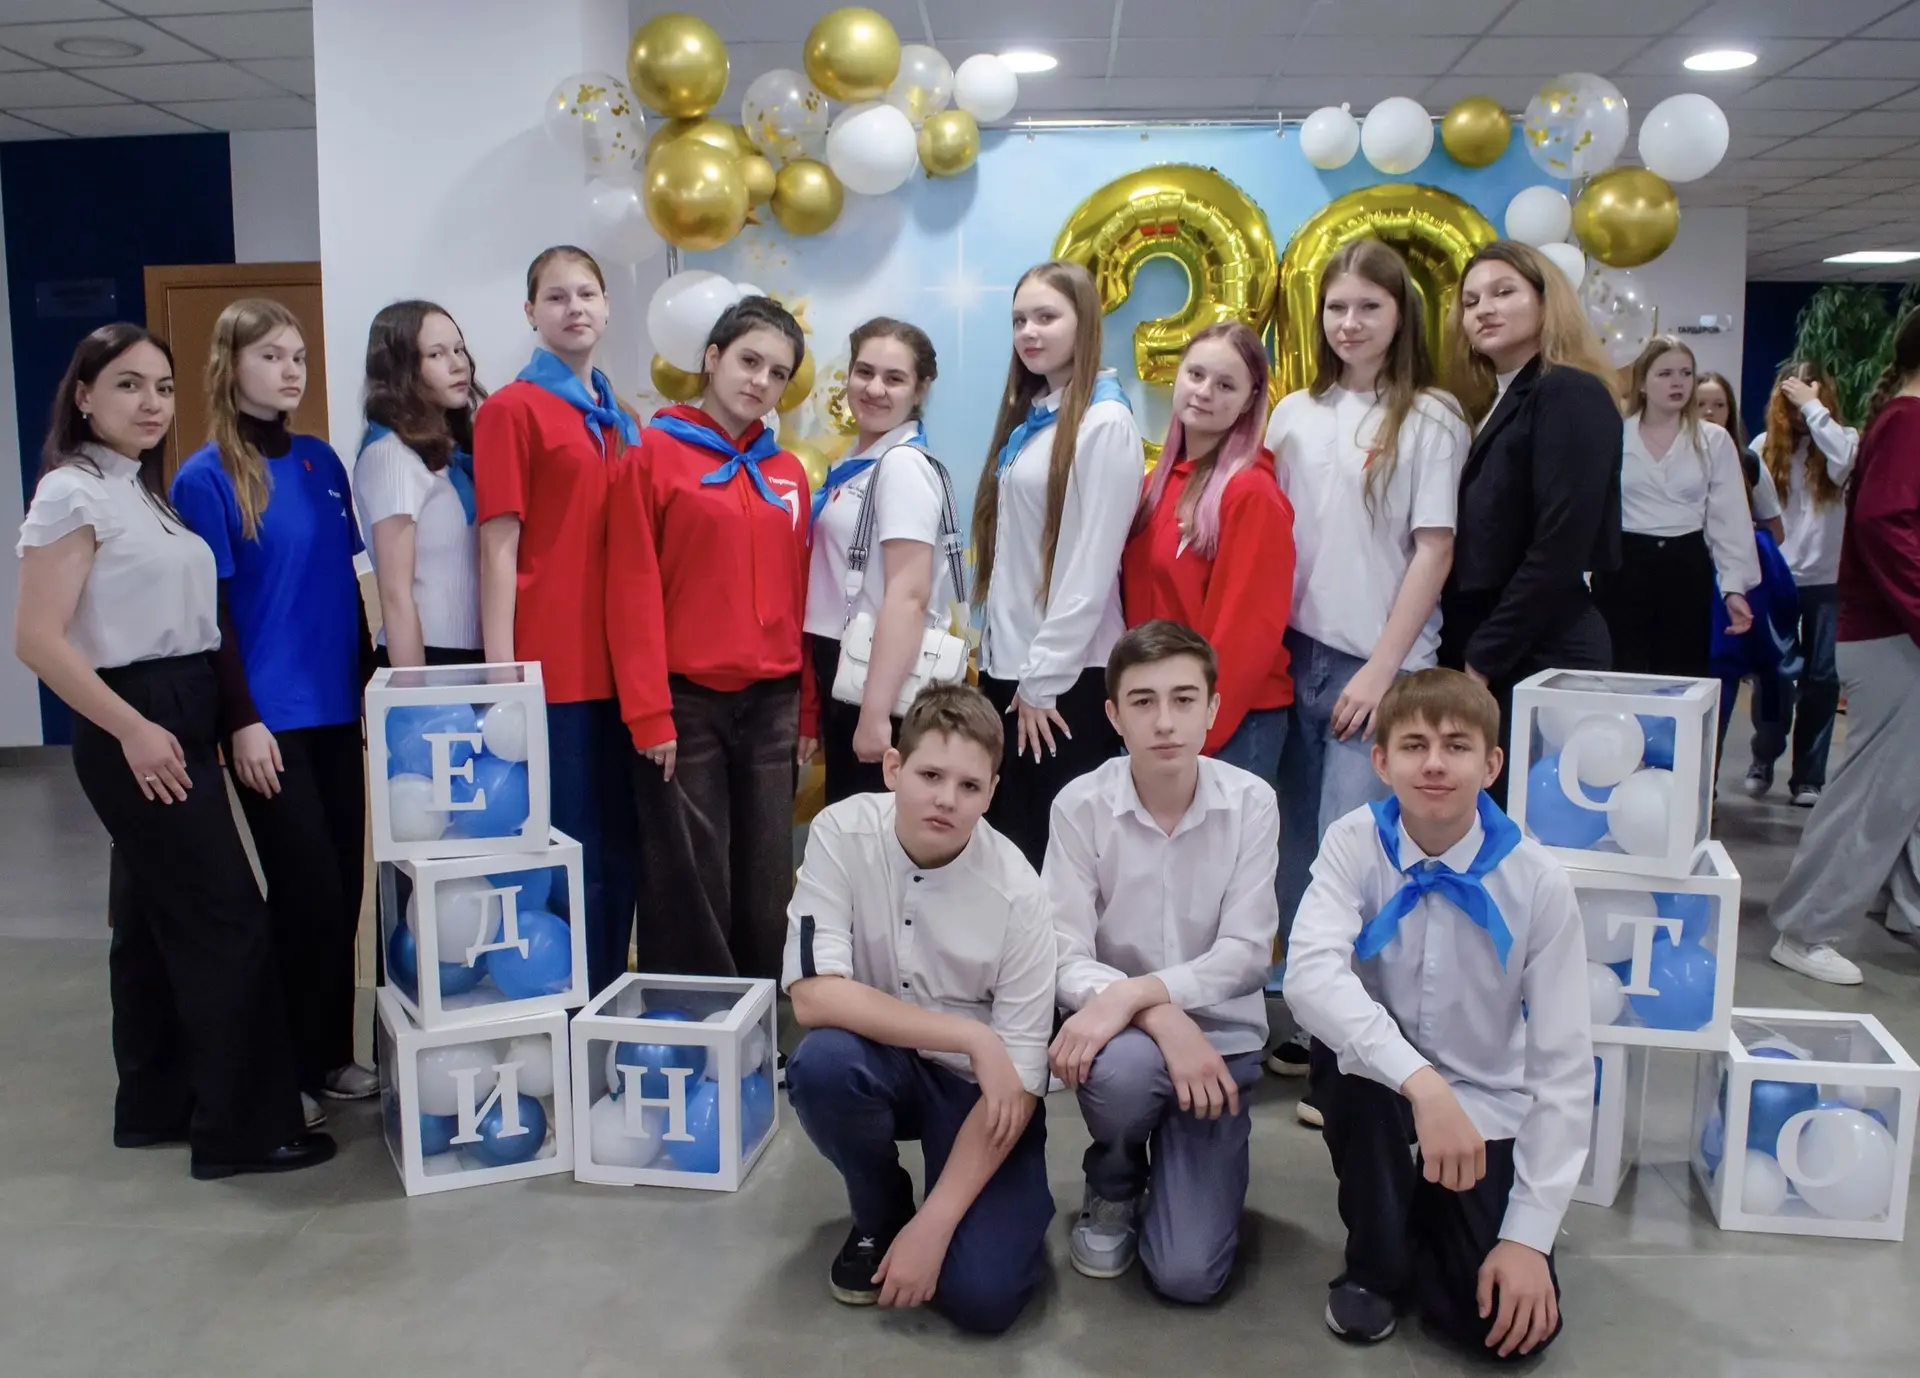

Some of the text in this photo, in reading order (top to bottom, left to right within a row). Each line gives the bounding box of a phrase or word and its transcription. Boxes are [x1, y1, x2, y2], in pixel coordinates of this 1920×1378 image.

[422, 732, 486, 811] Е
[466, 886, 529, 968] Д
[1607, 914, 1683, 997] Т
[448, 1061, 696, 1144] И Н
